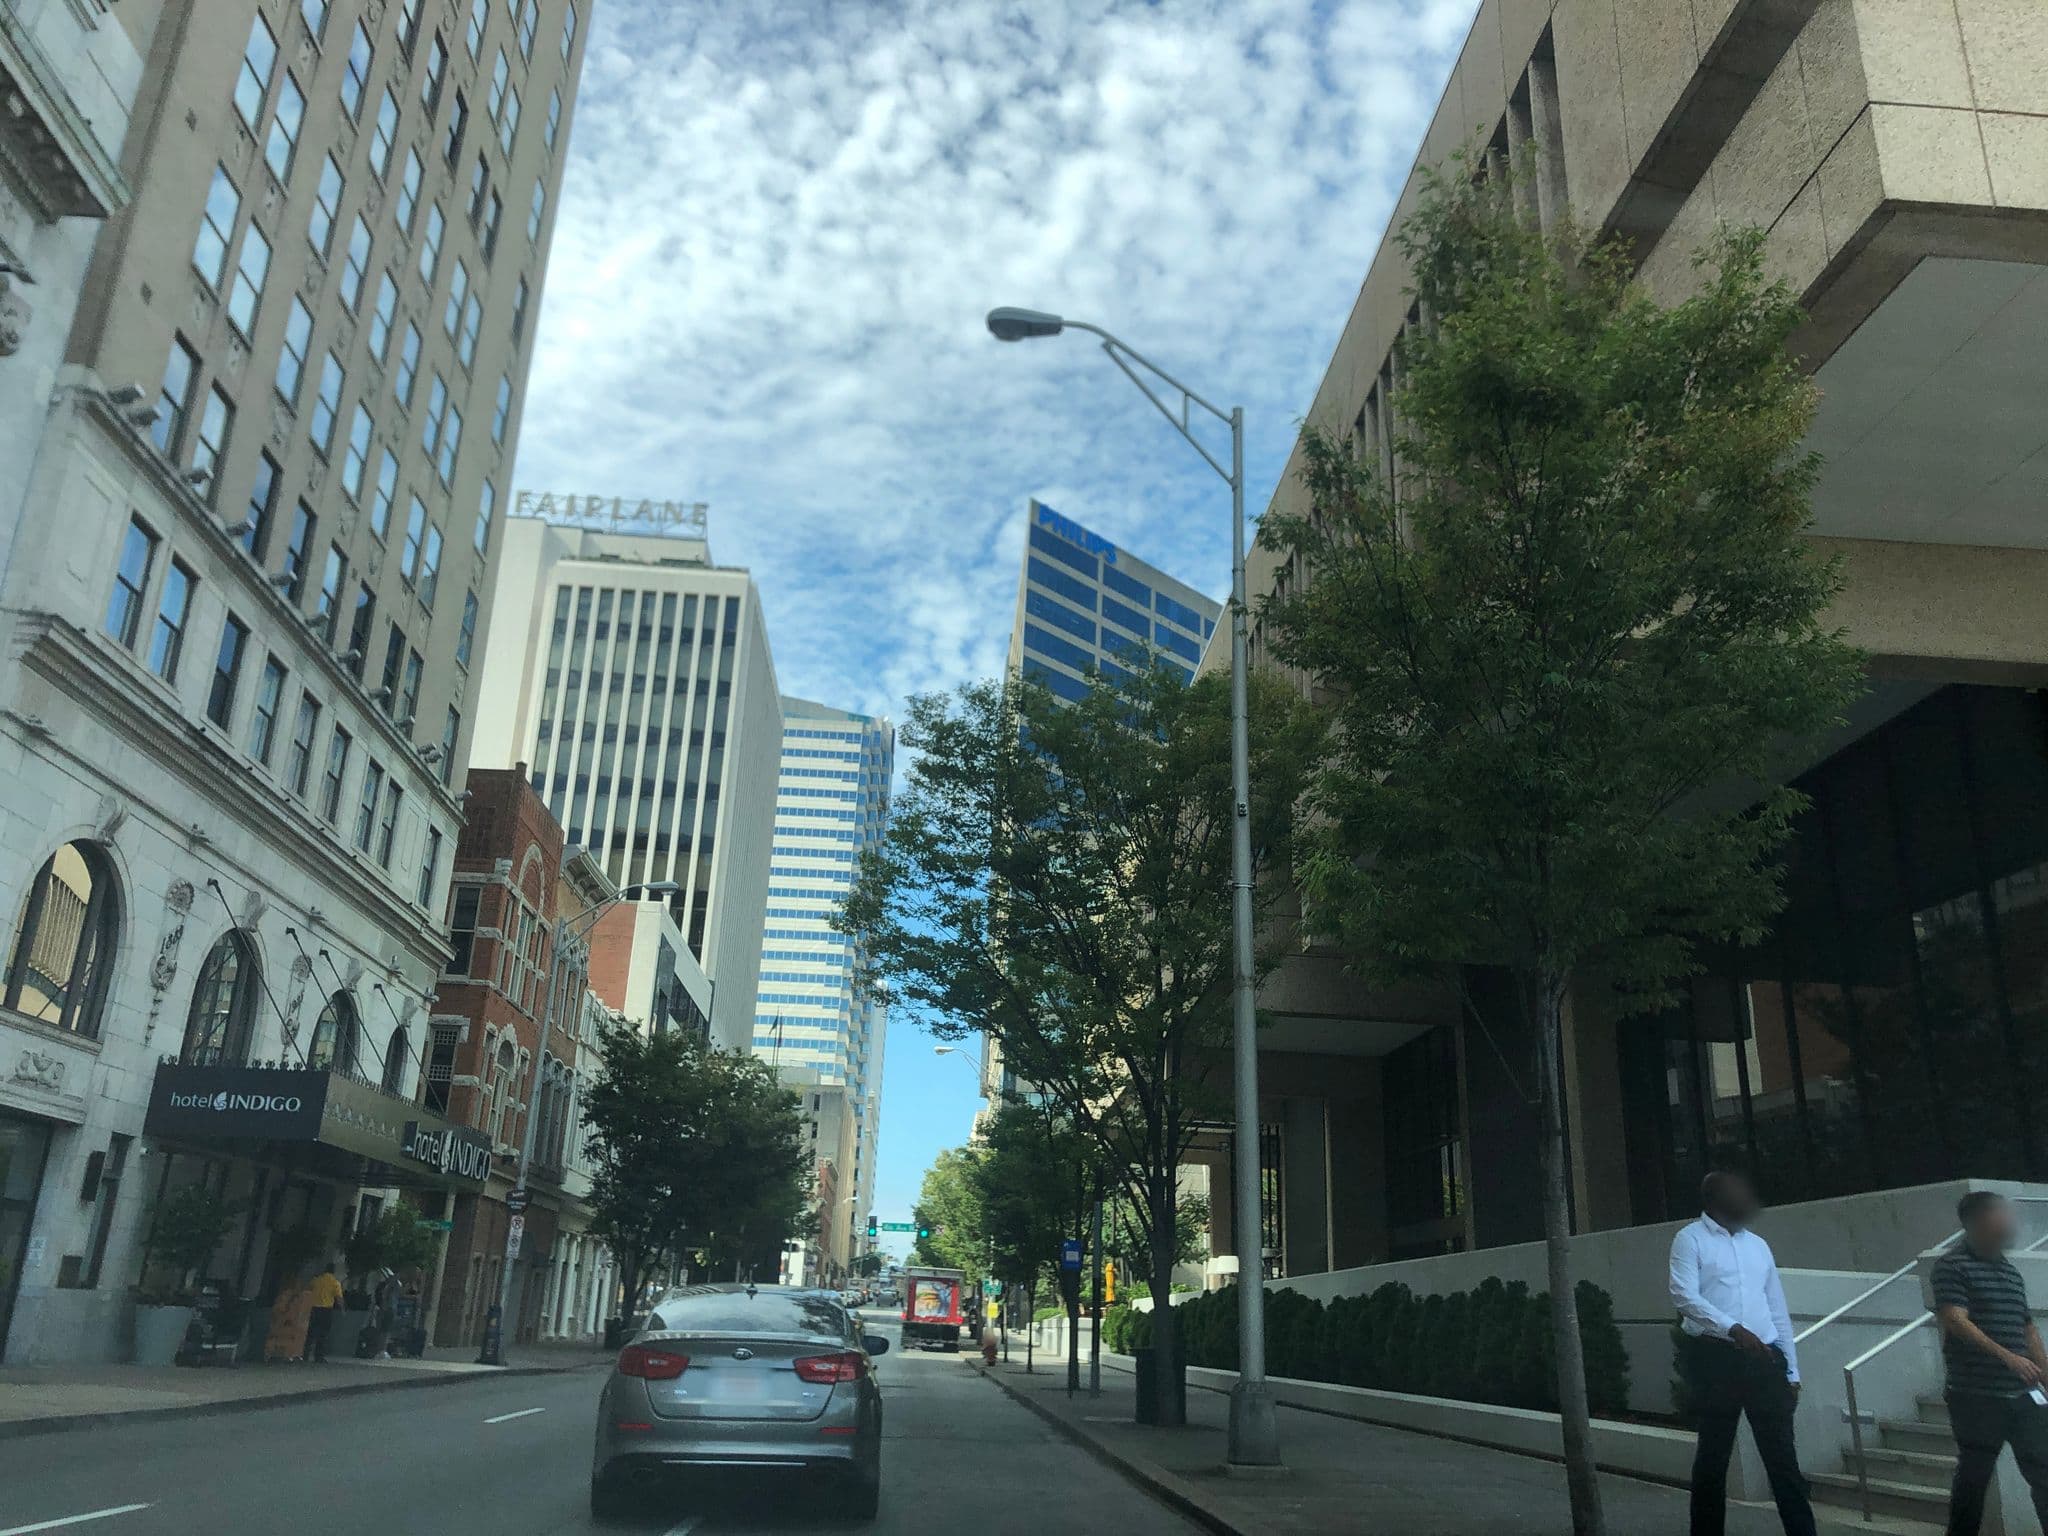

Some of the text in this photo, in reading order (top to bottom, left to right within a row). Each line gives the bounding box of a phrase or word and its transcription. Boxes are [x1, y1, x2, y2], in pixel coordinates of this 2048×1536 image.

[170, 1091, 301, 1112] hotel INDIGO
[412, 1122, 491, 1181] hotel INDIGO
